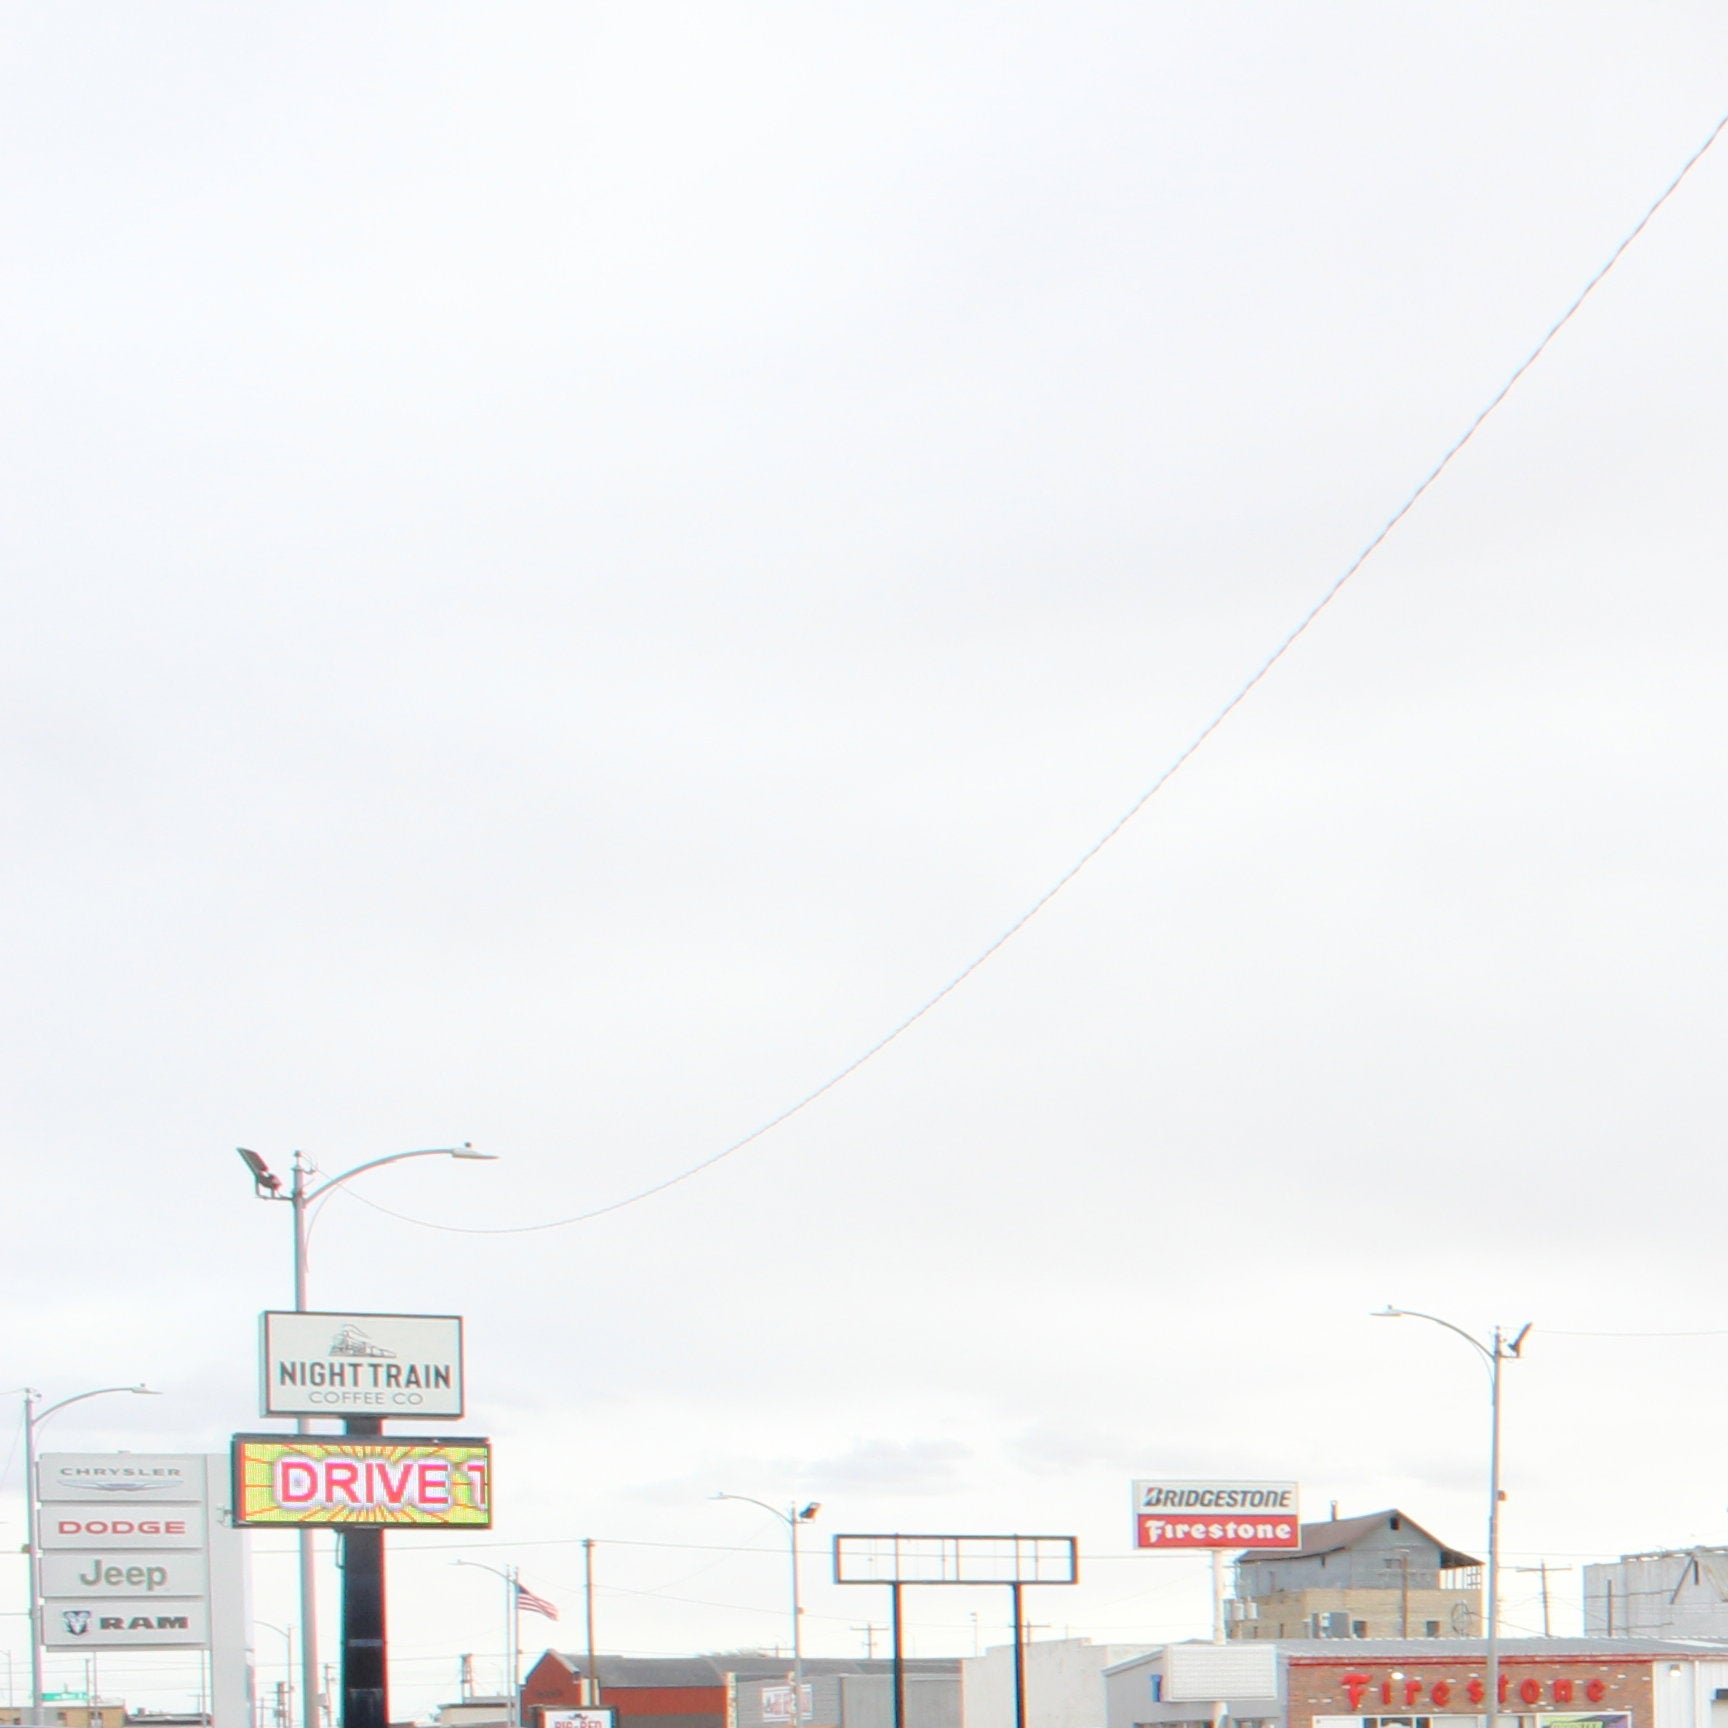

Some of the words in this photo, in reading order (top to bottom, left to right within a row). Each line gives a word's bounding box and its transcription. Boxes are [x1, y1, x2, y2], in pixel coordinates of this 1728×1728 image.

[279, 1361, 364, 1387] NIGHT
[368, 1363, 451, 1389] TRAIN
[308, 1391, 385, 1405] COFFEE
[392, 1392, 424, 1406] CO
[60, 1467, 181, 1476] CHRYSLER
[281, 1461, 449, 1504] DRIVE
[1143, 1487, 1292, 1507] BRIDGESTONE
[58, 1521, 186, 1534] DODGE
[1144, 1519, 1292, 1544] Firestone
[79, 1559, 168, 1591] Jeep
[99, 1616, 189, 1630] RAM
[1340, 1673, 1605, 1711] Firestone
